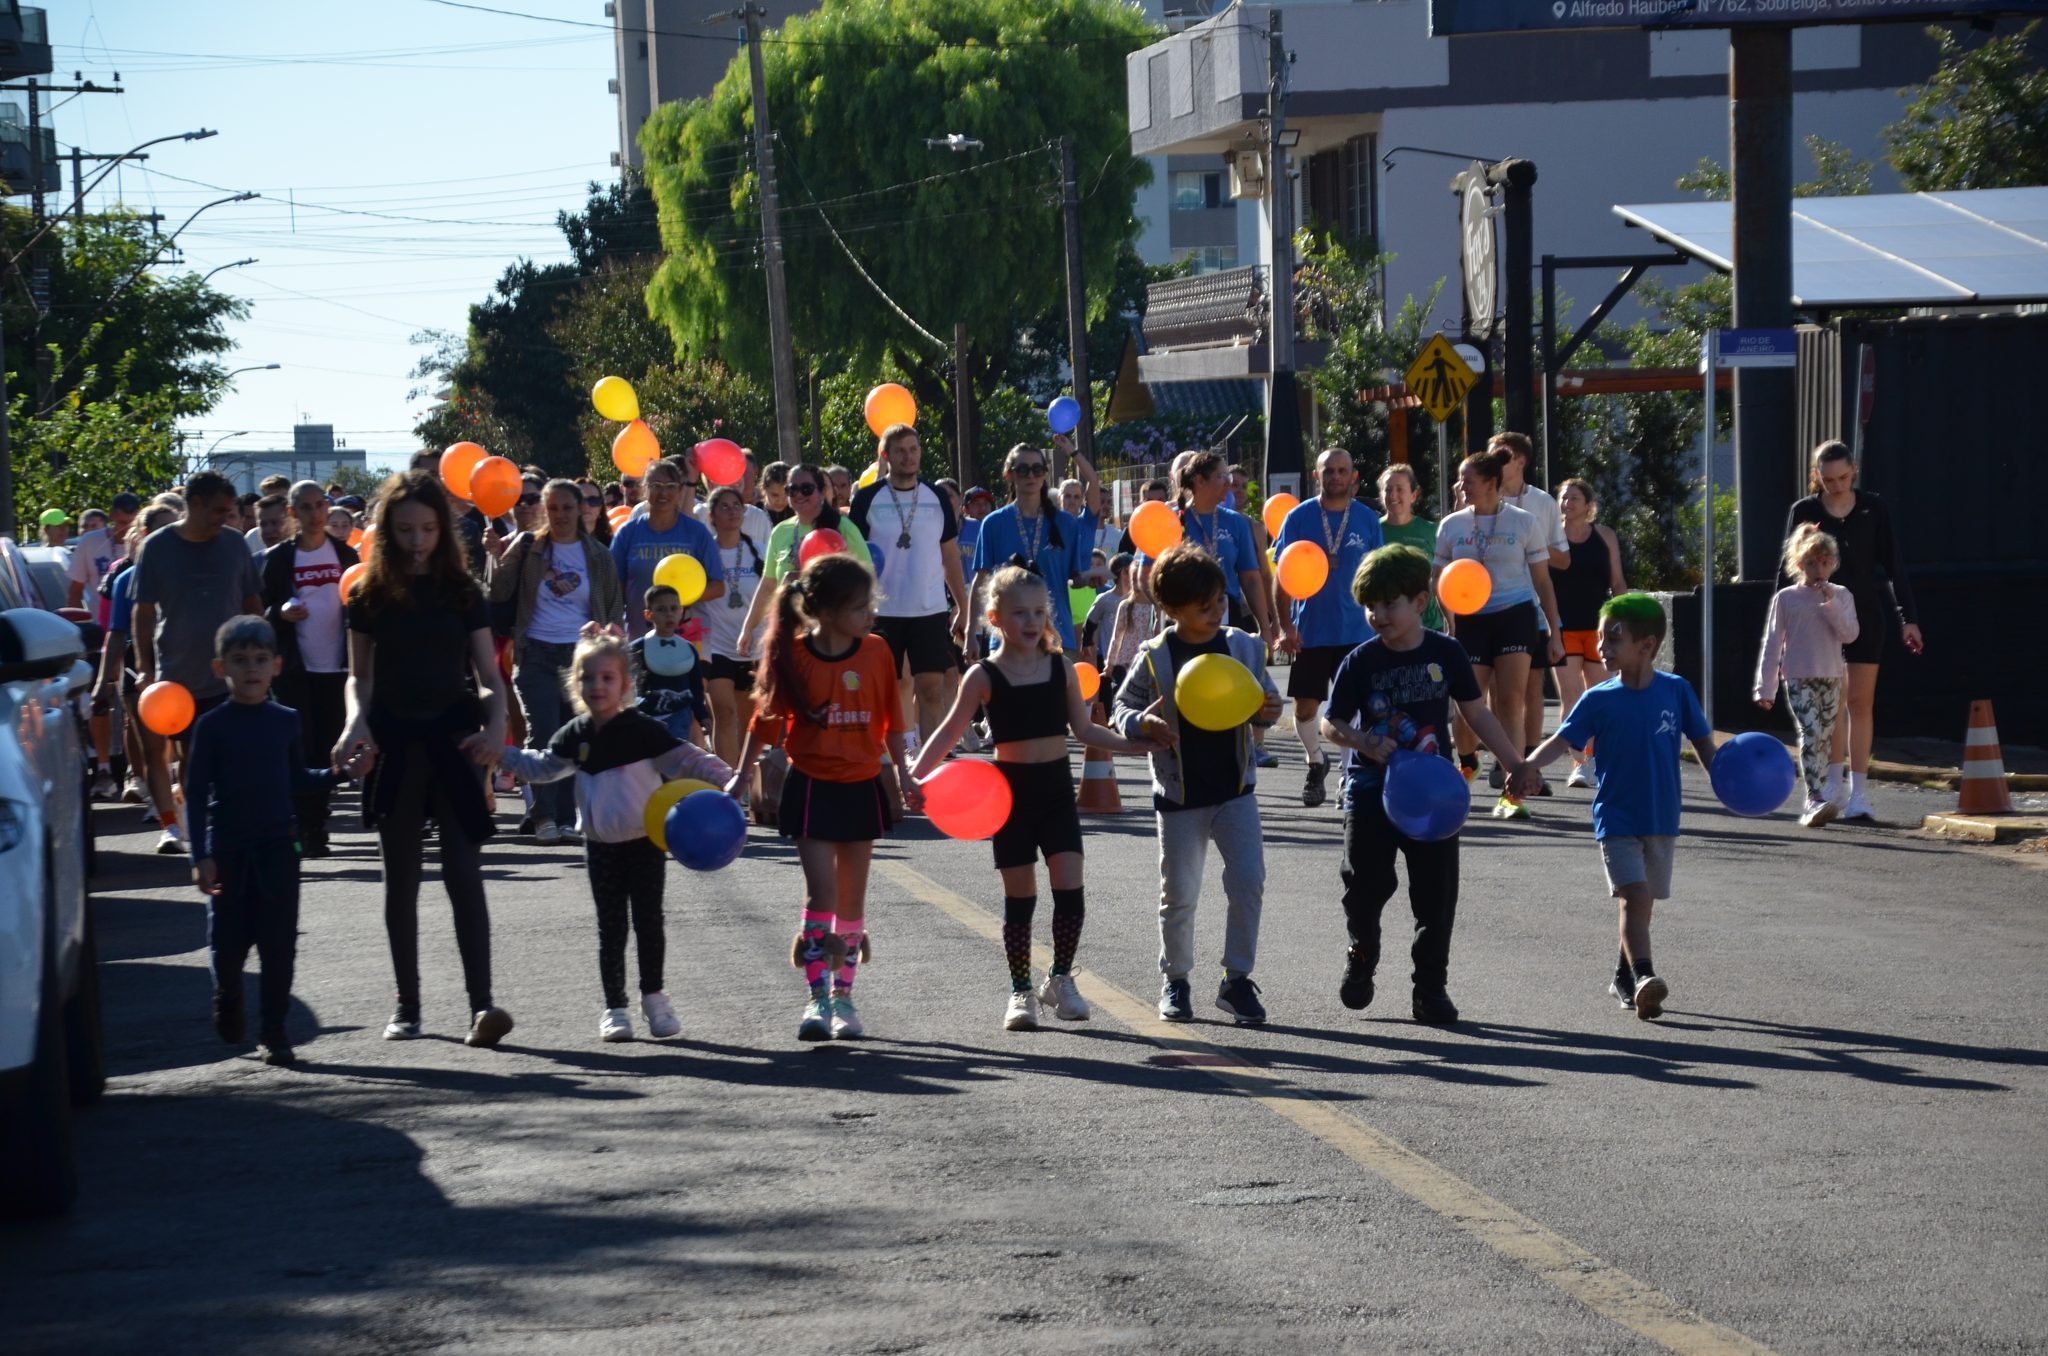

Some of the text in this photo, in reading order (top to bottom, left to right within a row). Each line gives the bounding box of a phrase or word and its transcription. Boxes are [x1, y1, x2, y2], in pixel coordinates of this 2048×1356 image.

[1570, 0, 1624, 17] Alfredo
[1740, 336, 1773, 345] RIO DE
[1736, 345, 1776, 353] JANEIRO
